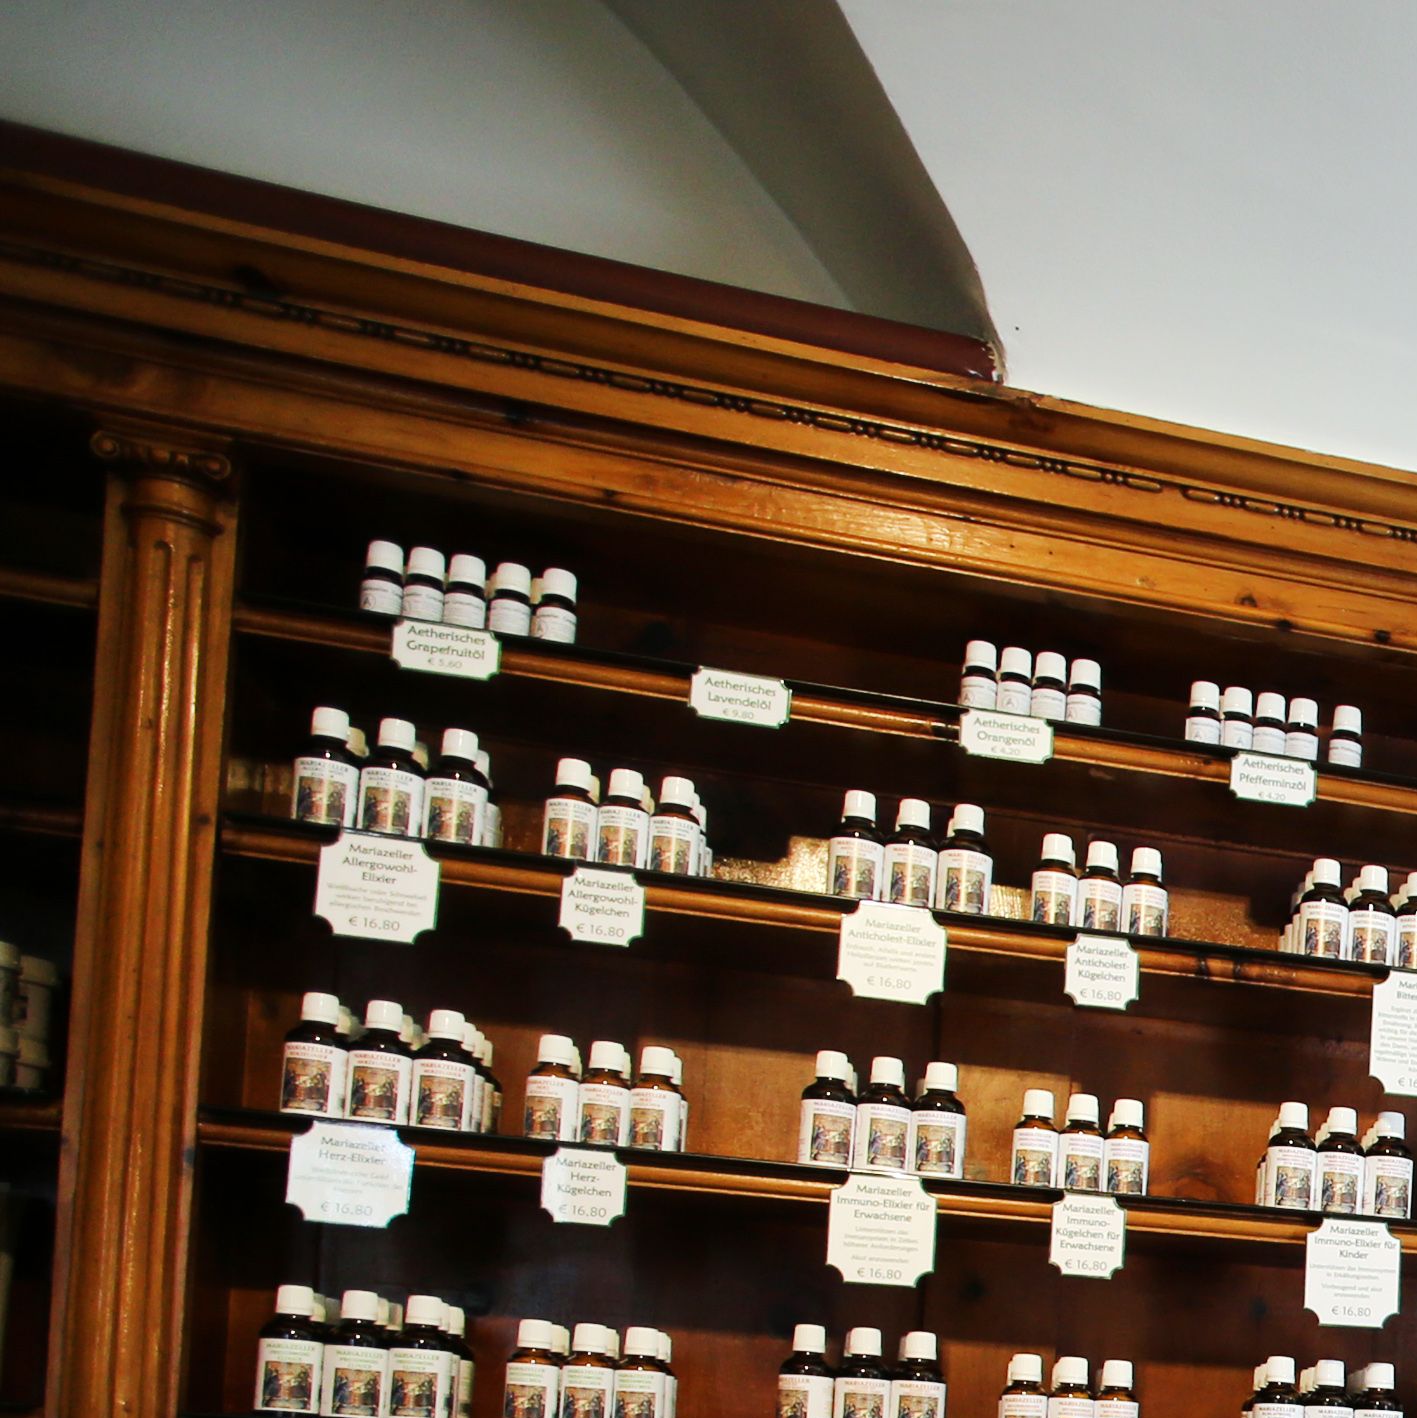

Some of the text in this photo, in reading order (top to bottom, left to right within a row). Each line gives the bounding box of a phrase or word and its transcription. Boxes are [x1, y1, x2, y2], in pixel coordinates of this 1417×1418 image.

[408, 626, 486, 646] Aetherisches
[406, 641, 486, 660] Grapefruitöl
[705, 677, 777, 697] Aetherisches
[708, 692, 771, 710] Lavendelöl
[974, 717, 1040, 735] Aetherisches
[977, 731, 1036, 747] Orangenöl
[1243, 758, 1304, 775] Aetherisches
[1240, 772, 1306, 791] Pfefferminzöl
[349, 844, 413, 861] Mariazeller
[342, 857, 418, 873] Allergowohl-
[362, 872, 396, 884] Elixier
[574, 877, 635, 892] Mariazeller
[567, 889, 638, 906] Allergowohl-
[575, 903, 631, 918] Kügelchen
[865, 919, 922, 933] Mariazeller
[849, 930, 937, 948] Anticholest-Elixier
[1076, 945, 1129, 959] Mariazeller
[1074, 956, 1130, 970] Anticholest-
[1078, 969, 1126, 982] Kügelchen
[318, 1150, 387, 1166] Herz-Elixier
[557, 1156, 617, 1172] Mariazeller
[570, 1171, 600, 1183] Herz-
[557, 1184, 612, 1198] Kügelchen
[856, 1184, 913, 1198] Mariazeller
[837, 1196, 930, 1210] Immuno-Elixier für
[1062, 1203, 1115, 1216] Mariazeller
[854, 1209, 913, 1223] Erwachsene
[1067, 1217, 1110, 1227] Immuno-
[1055, 1228, 1120, 1241] Kügelchen für
[1330, 1225, 1380, 1237] Mariazeller
[1060, 1240, 1115, 1252] Erwachsene
[1314, 1237, 1397, 1249] Immuno-Elixier für
[1339, 1249, 1369, 1260] Kinder
